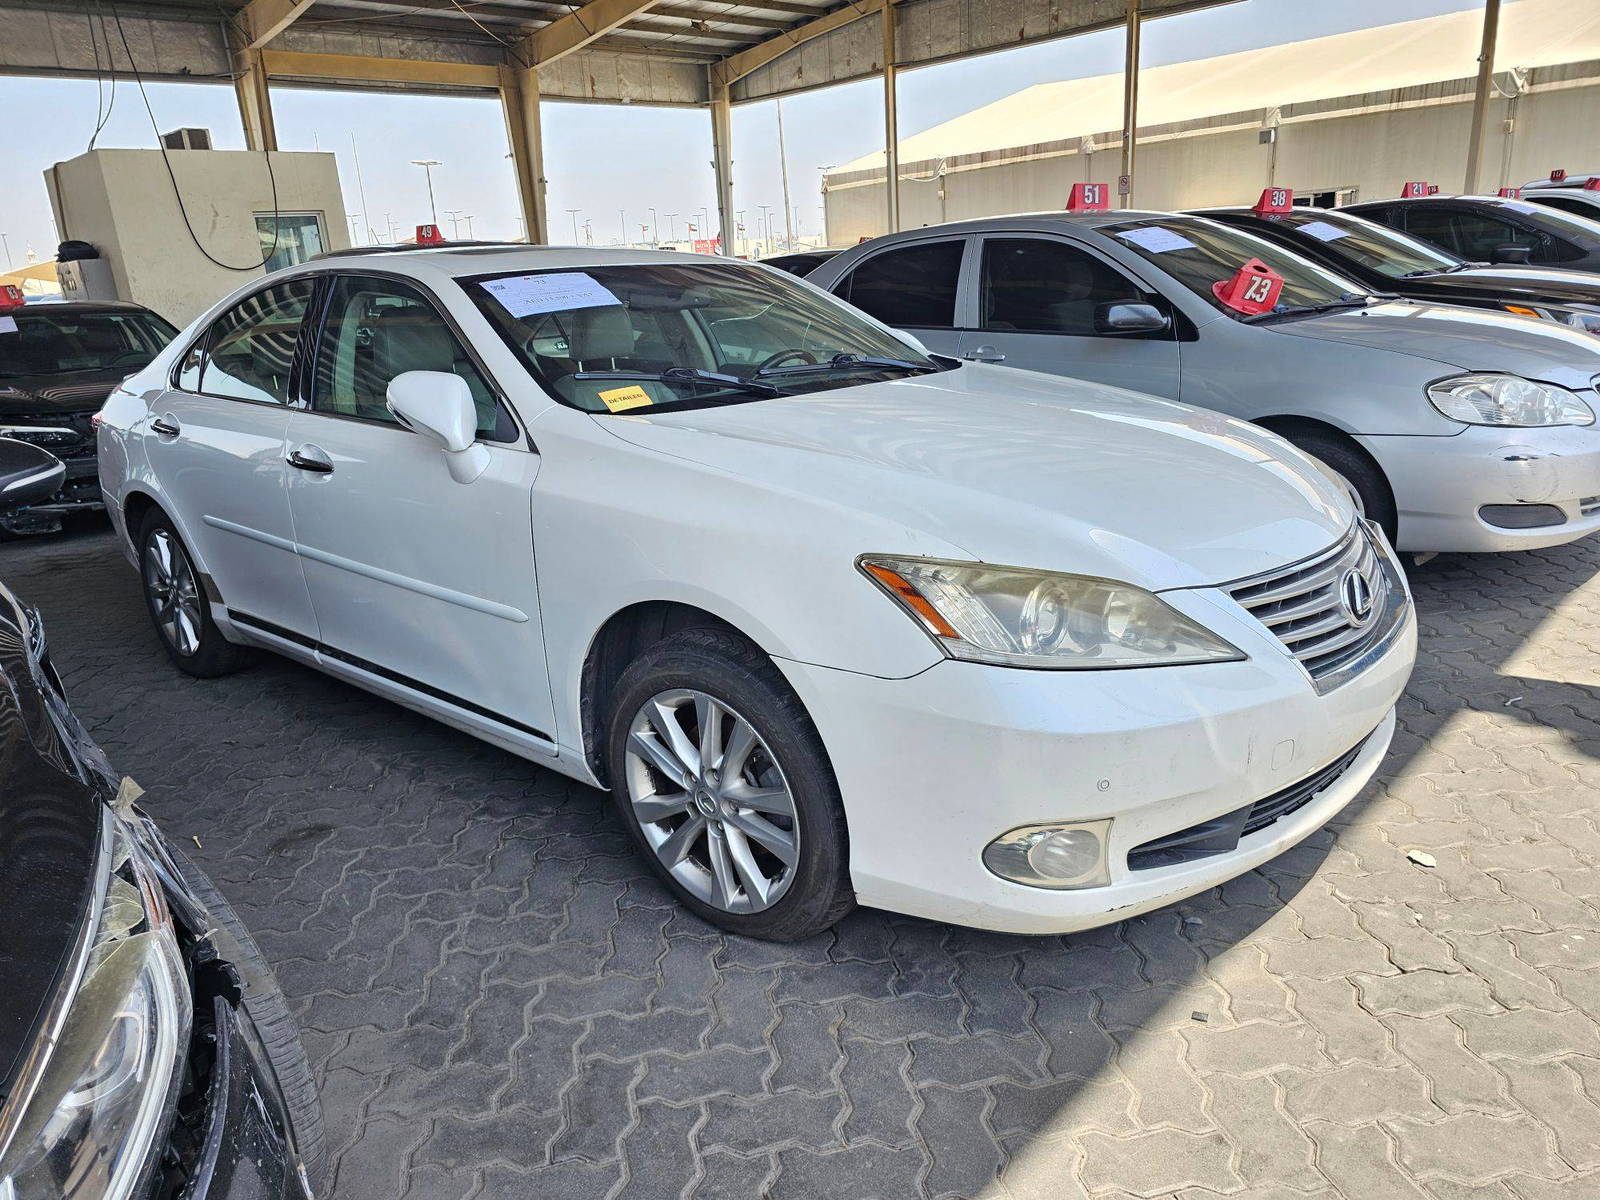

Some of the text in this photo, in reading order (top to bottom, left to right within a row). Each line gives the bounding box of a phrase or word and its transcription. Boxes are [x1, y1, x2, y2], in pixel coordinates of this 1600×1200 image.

[1084, 184, 1100, 204] 51
[1413, 183, 1423, 195] 21
[1271, 190, 1287, 207] 38
[421, 225, 432, 238] 49
[1244, 275, 1273, 303] 73
[608, 393, 643, 404] DETAILED
